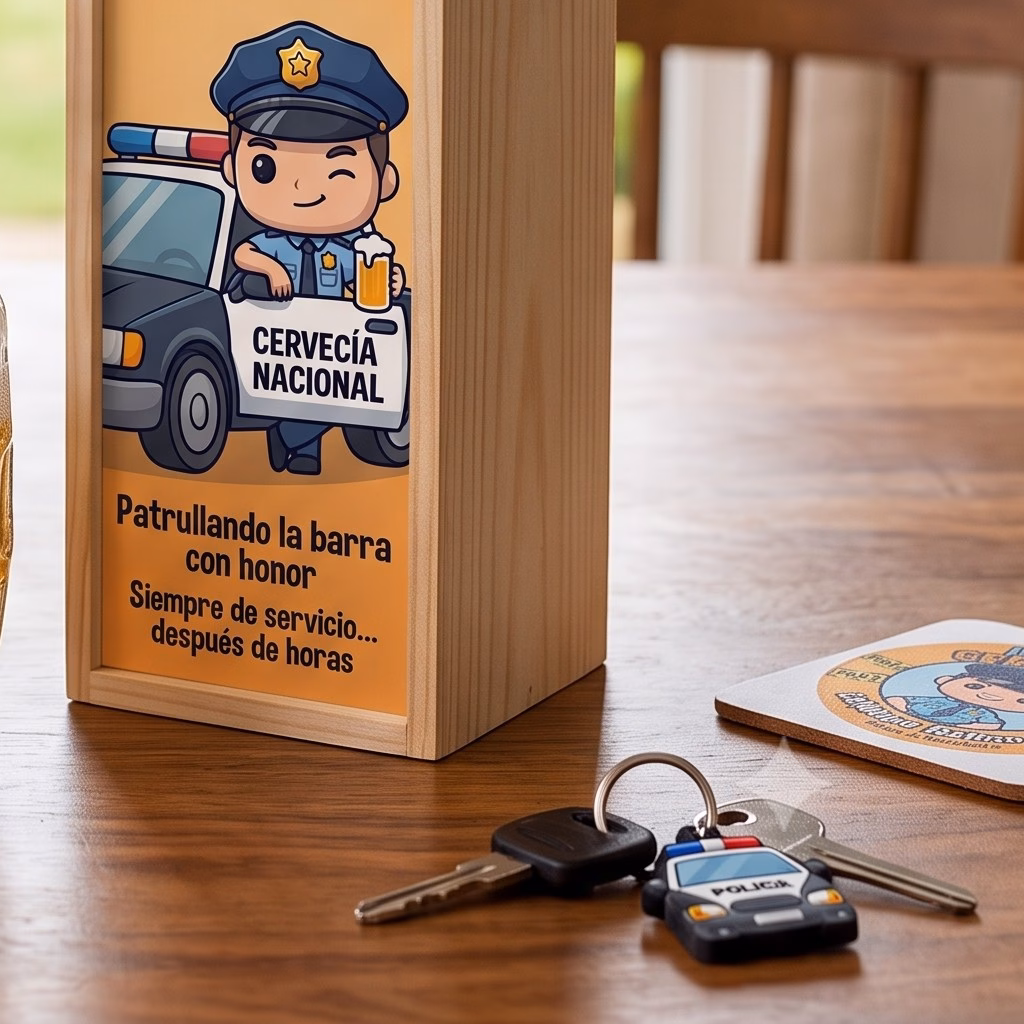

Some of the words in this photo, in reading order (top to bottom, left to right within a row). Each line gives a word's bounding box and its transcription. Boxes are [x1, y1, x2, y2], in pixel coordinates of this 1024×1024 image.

[253, 326, 378, 366] CERVECÍA
[253, 361, 384, 404] NACIONAL
[116, 493, 271, 545] Patrullando
[279, 516, 302, 550] la
[310, 520, 392, 563] barra
[186, 548, 231, 577] con
[239, 548, 317, 589] honor
[129, 580, 223, 622] Siempre
[230, 597, 257, 625] de
[264, 608, 378, 643] servicio...
[151, 618, 244, 657] después
[251, 634, 278, 662] de
[286, 637, 354, 674] horas
